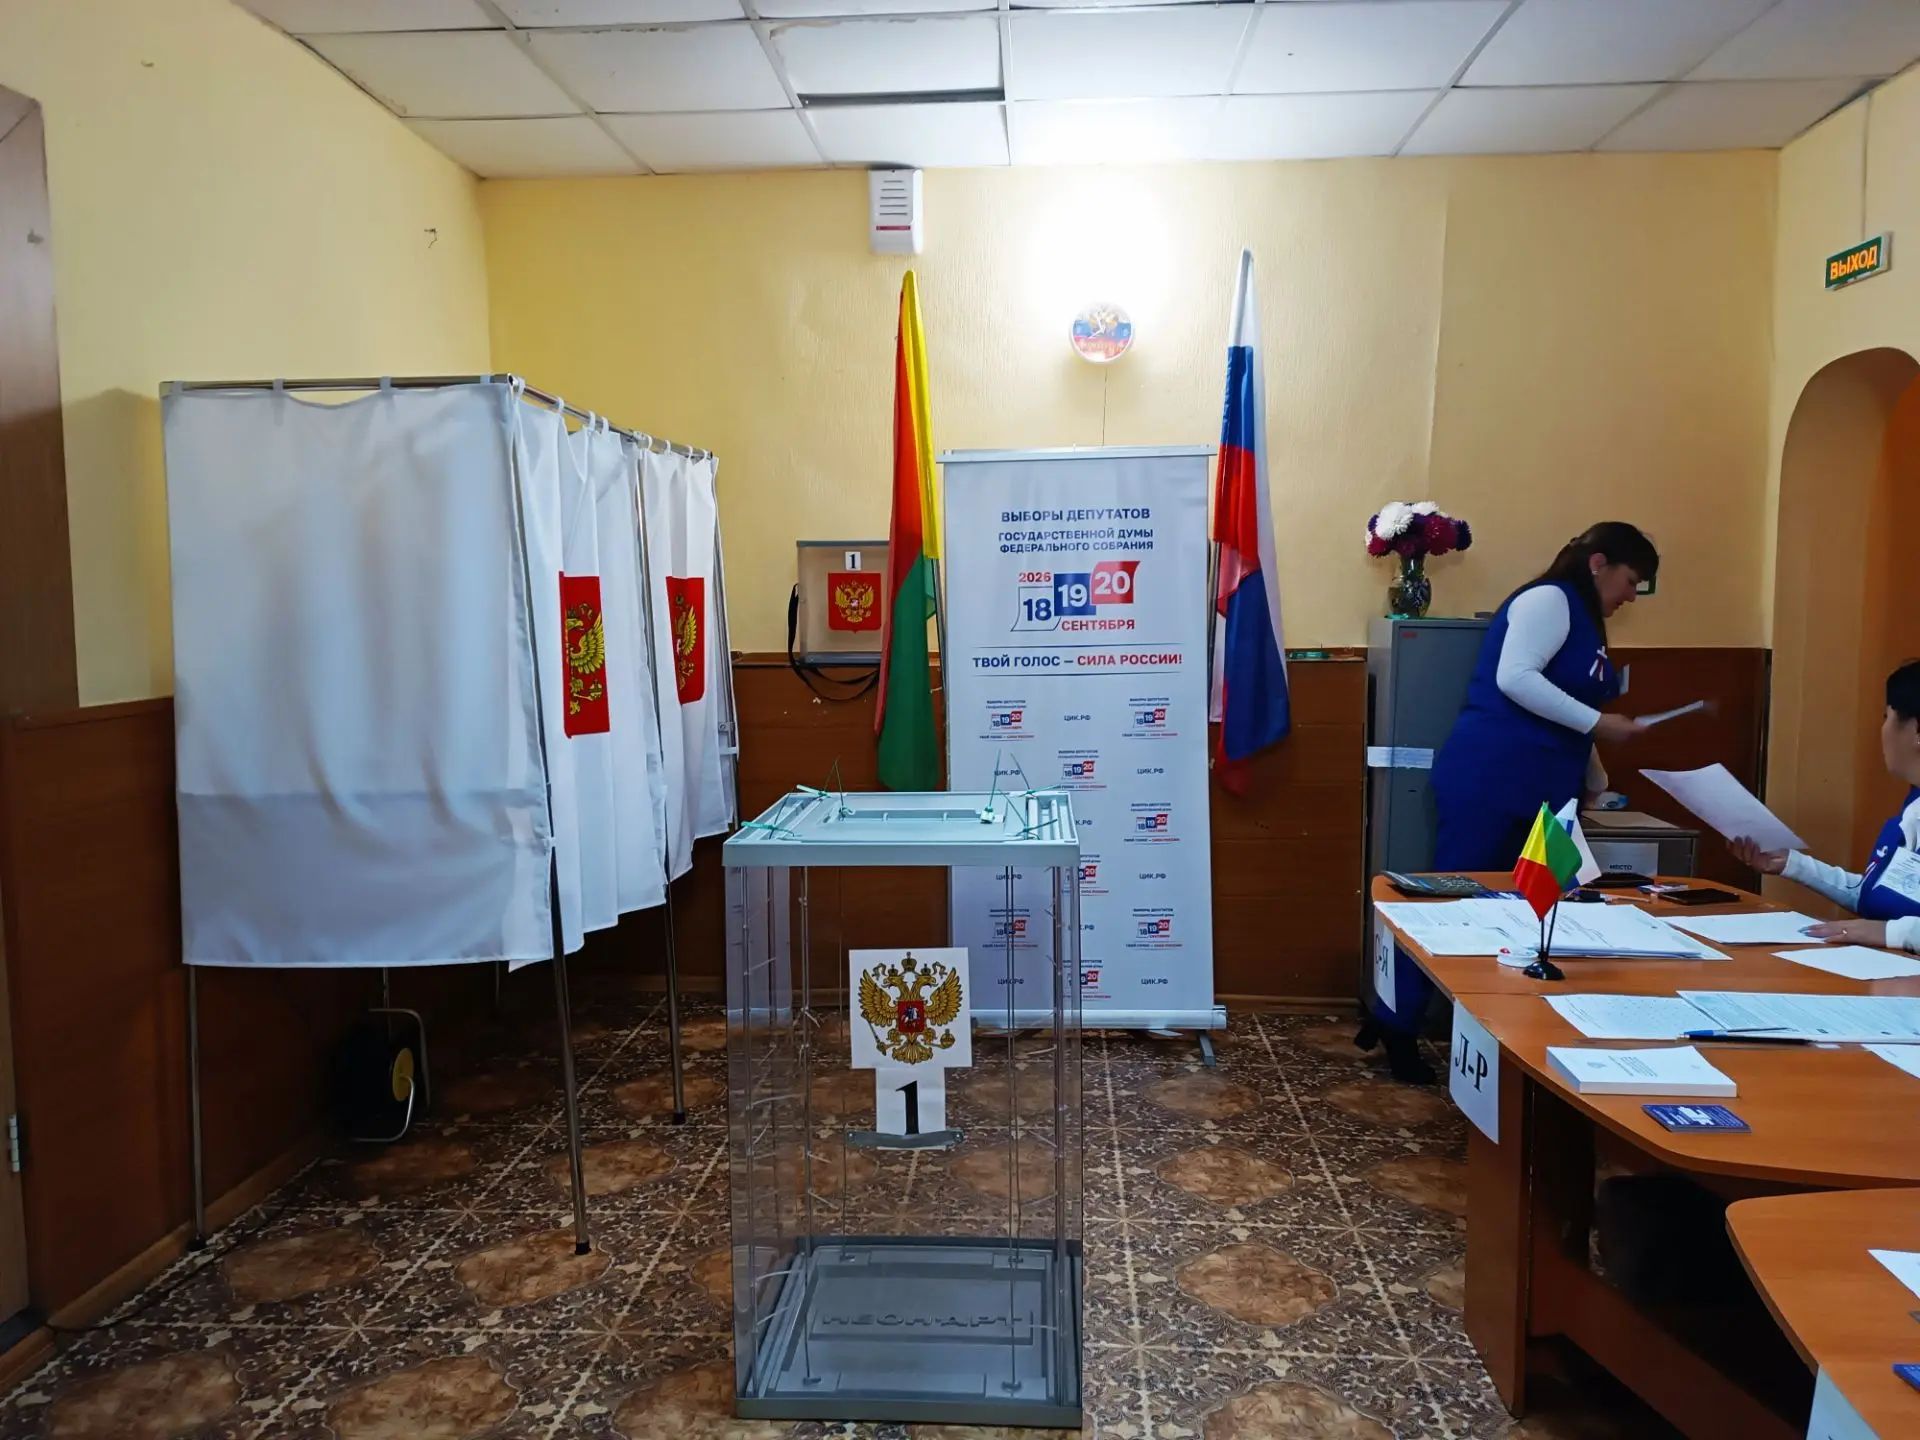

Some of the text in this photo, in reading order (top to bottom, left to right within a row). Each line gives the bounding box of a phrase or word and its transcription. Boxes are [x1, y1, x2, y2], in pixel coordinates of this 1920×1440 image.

[1830, 245, 1878, 280] ВЫХОД
[1001, 508, 1150, 522] ВЫБОРЫ ДЕПУТАТОВ
[998, 528, 1153, 541] ГОСУДАРСТВЕННОЙ ДУМЫ
[1000, 541, 1153, 554] ФЕДЕРАЛЬНОГО СОБРАНИЯ
[849, 553, 857, 569] 1
[1018, 572, 1051, 583] 2026
[1023, 570, 1131, 622] 18 19 20
[1061, 619, 1135, 631] СЕНТЯБРЯ
[972, 655, 1010, 667] ТВОЙ
[1014, 655, 1060, 667] ГОЛОС
[1077, 655, 1116, 666] СИЛА
[1120, 654, 1183, 665] РОССИИ!
[1455, 1032, 1488, 1093] Л-Р
[896, 1080, 920, 1135] 1
